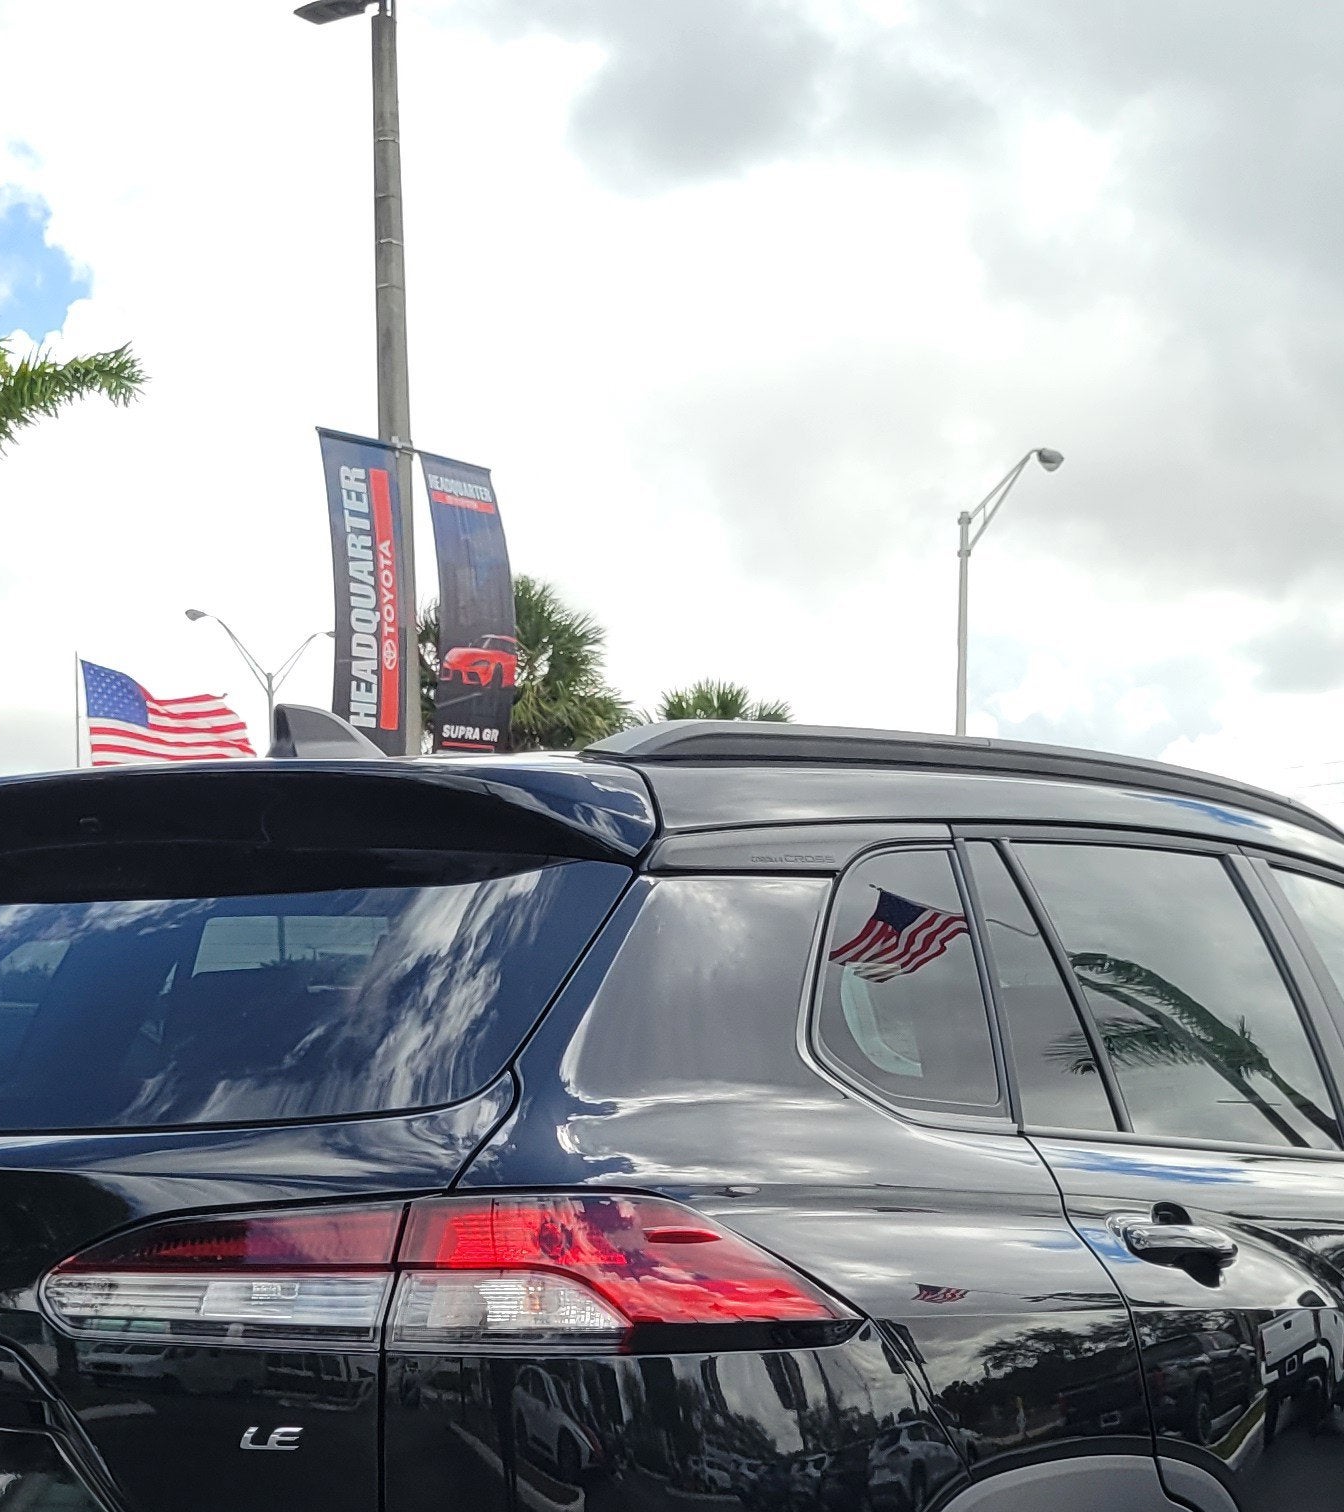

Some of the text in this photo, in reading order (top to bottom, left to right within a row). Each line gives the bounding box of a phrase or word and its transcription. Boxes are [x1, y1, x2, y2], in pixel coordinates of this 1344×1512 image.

[340, 465, 380, 729] HEADQUARTER
[378, 539, 398, 637] TOYOTA
[442, 724, 500, 743] SUPRA GR
[784, 854, 836, 864] CROSS
[239, 1426, 304, 1451] LE
